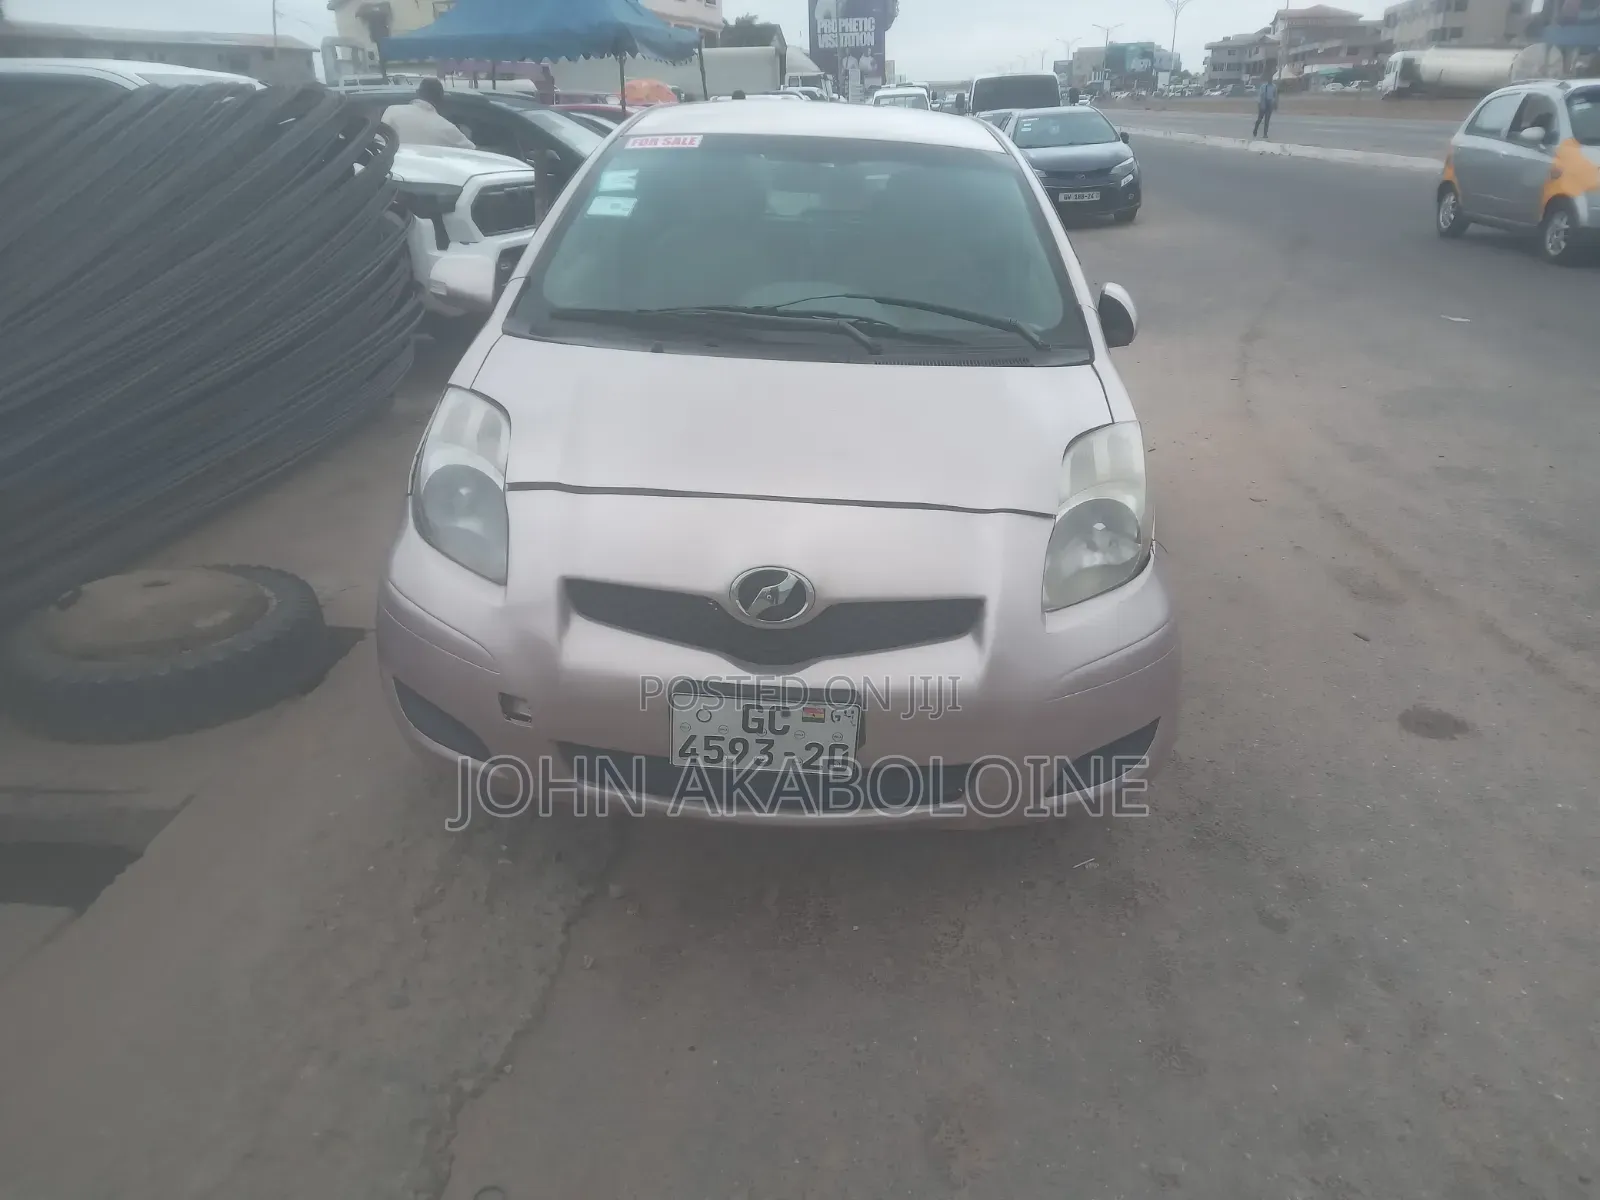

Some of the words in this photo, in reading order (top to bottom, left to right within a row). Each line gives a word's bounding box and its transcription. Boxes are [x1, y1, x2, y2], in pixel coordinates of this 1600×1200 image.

[817, 17, 875, 33] PROPHETIC
[631, 137, 659, 147] FOR
[661, 136, 697, 146] SALE
[742, 704, 790, 735] GC
